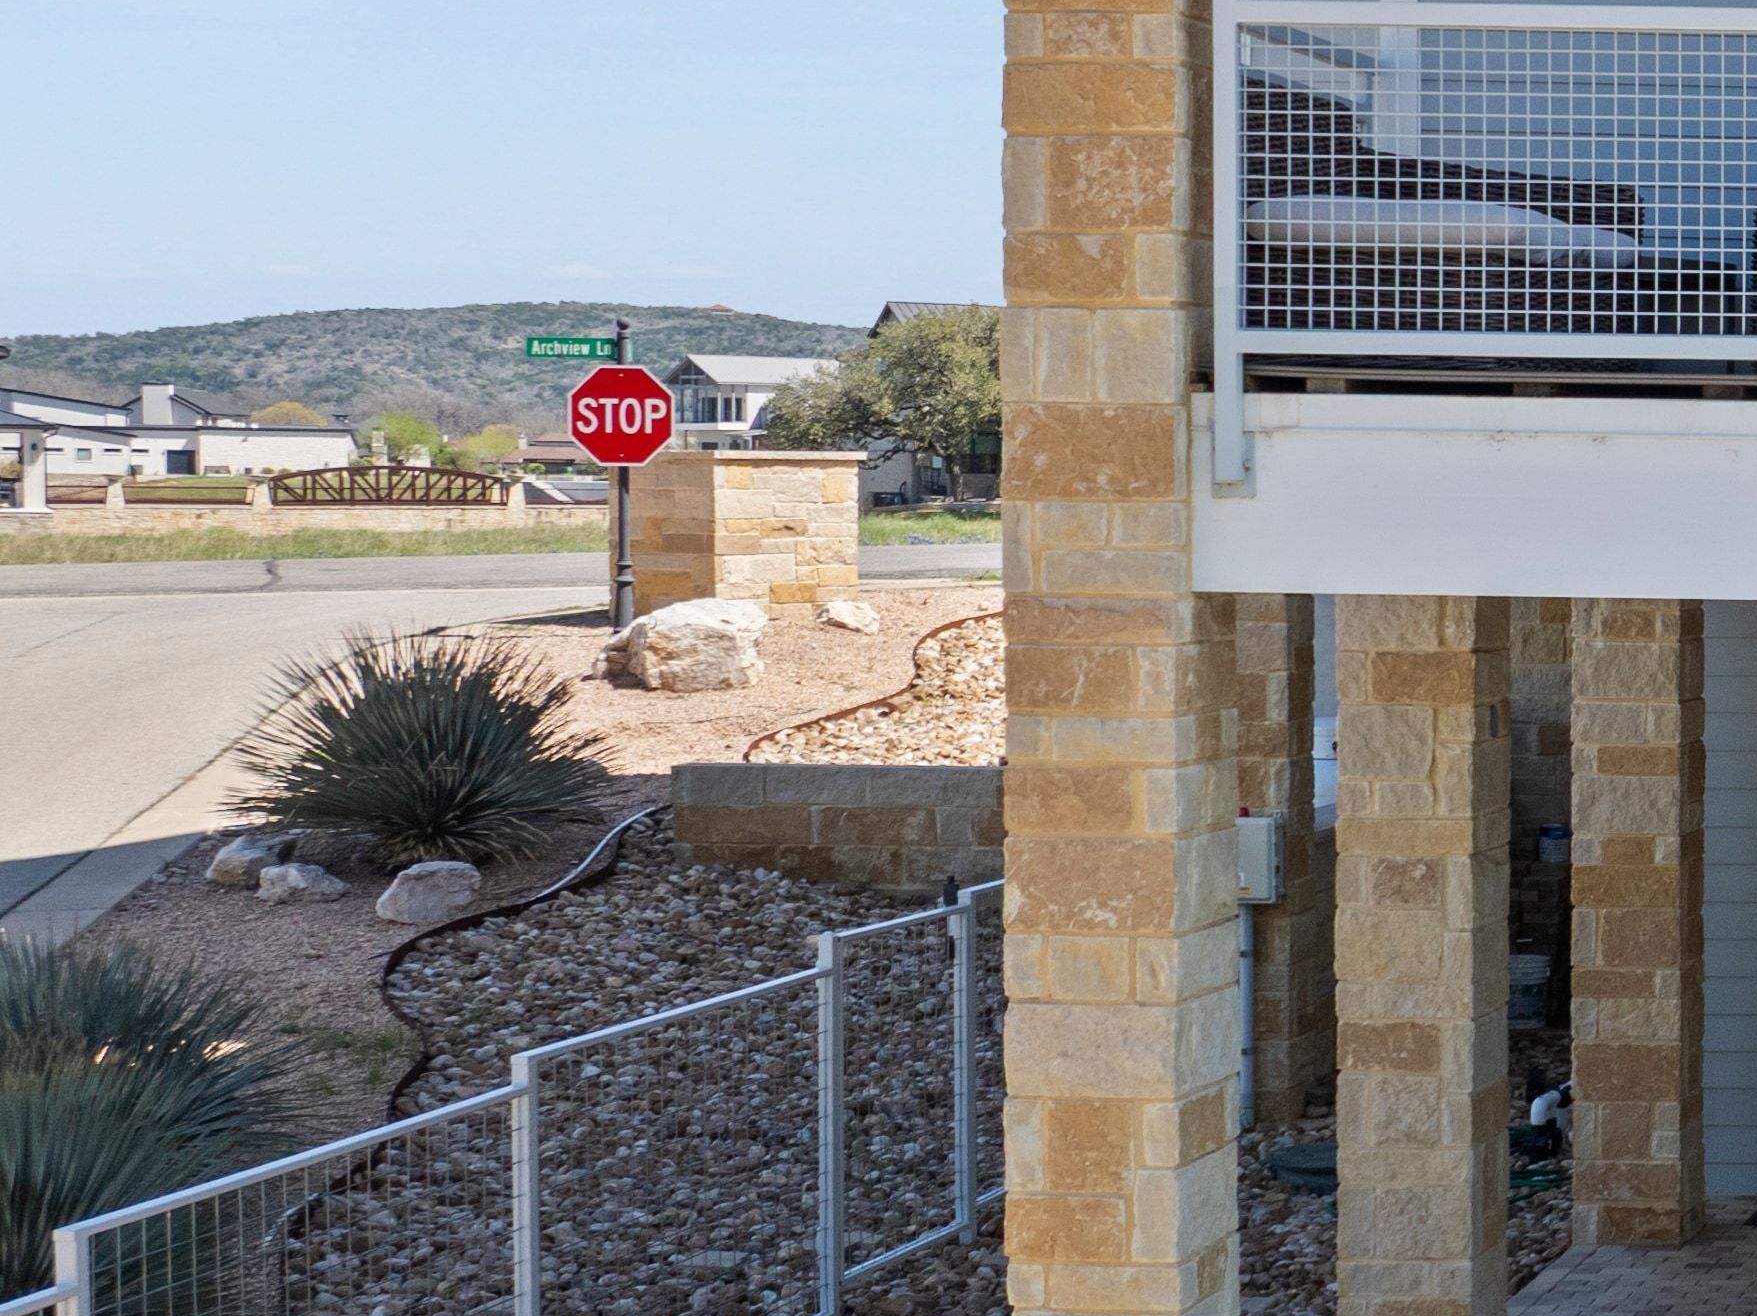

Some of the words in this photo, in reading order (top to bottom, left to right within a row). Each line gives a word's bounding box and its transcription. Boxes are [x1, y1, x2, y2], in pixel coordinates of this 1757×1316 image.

[532, 341, 590, 355] Archview
[597, 342, 612, 355] Ln
[576, 397, 668, 435] STOP
